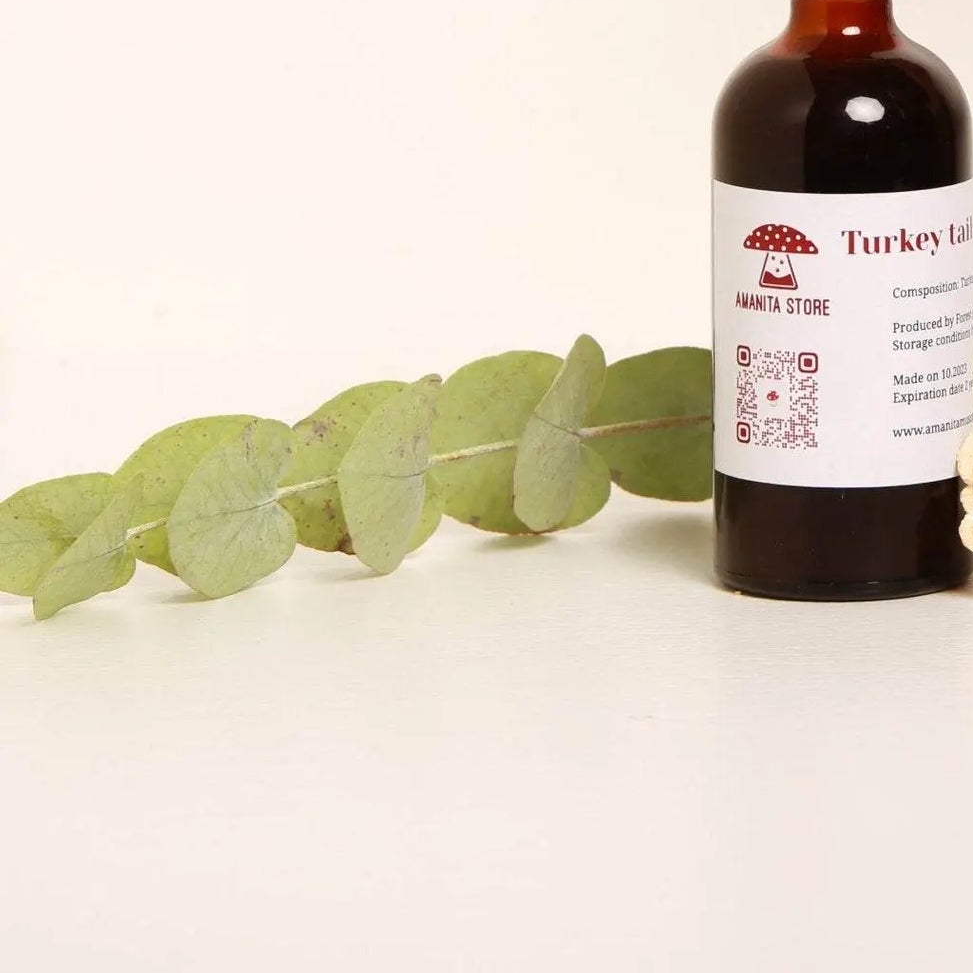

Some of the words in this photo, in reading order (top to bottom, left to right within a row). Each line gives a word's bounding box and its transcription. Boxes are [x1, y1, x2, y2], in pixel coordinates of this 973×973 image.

[841, 228, 943, 256] Turkey
[893, 279, 959, 299] Comsposition:
[735, 291, 781, 313] AMANITA
[786, 297, 830, 316] STORE
[893, 317, 942, 334] Produced
[944, 315, 954, 329] by
[893, 337, 933, 351] Storage
[893, 372, 924, 386] Made
[926, 372, 939, 382] on
[941, 363, 968, 378] 10.2023
[893, 386, 947, 405] Expiration
[949, 382, 964, 396] date
